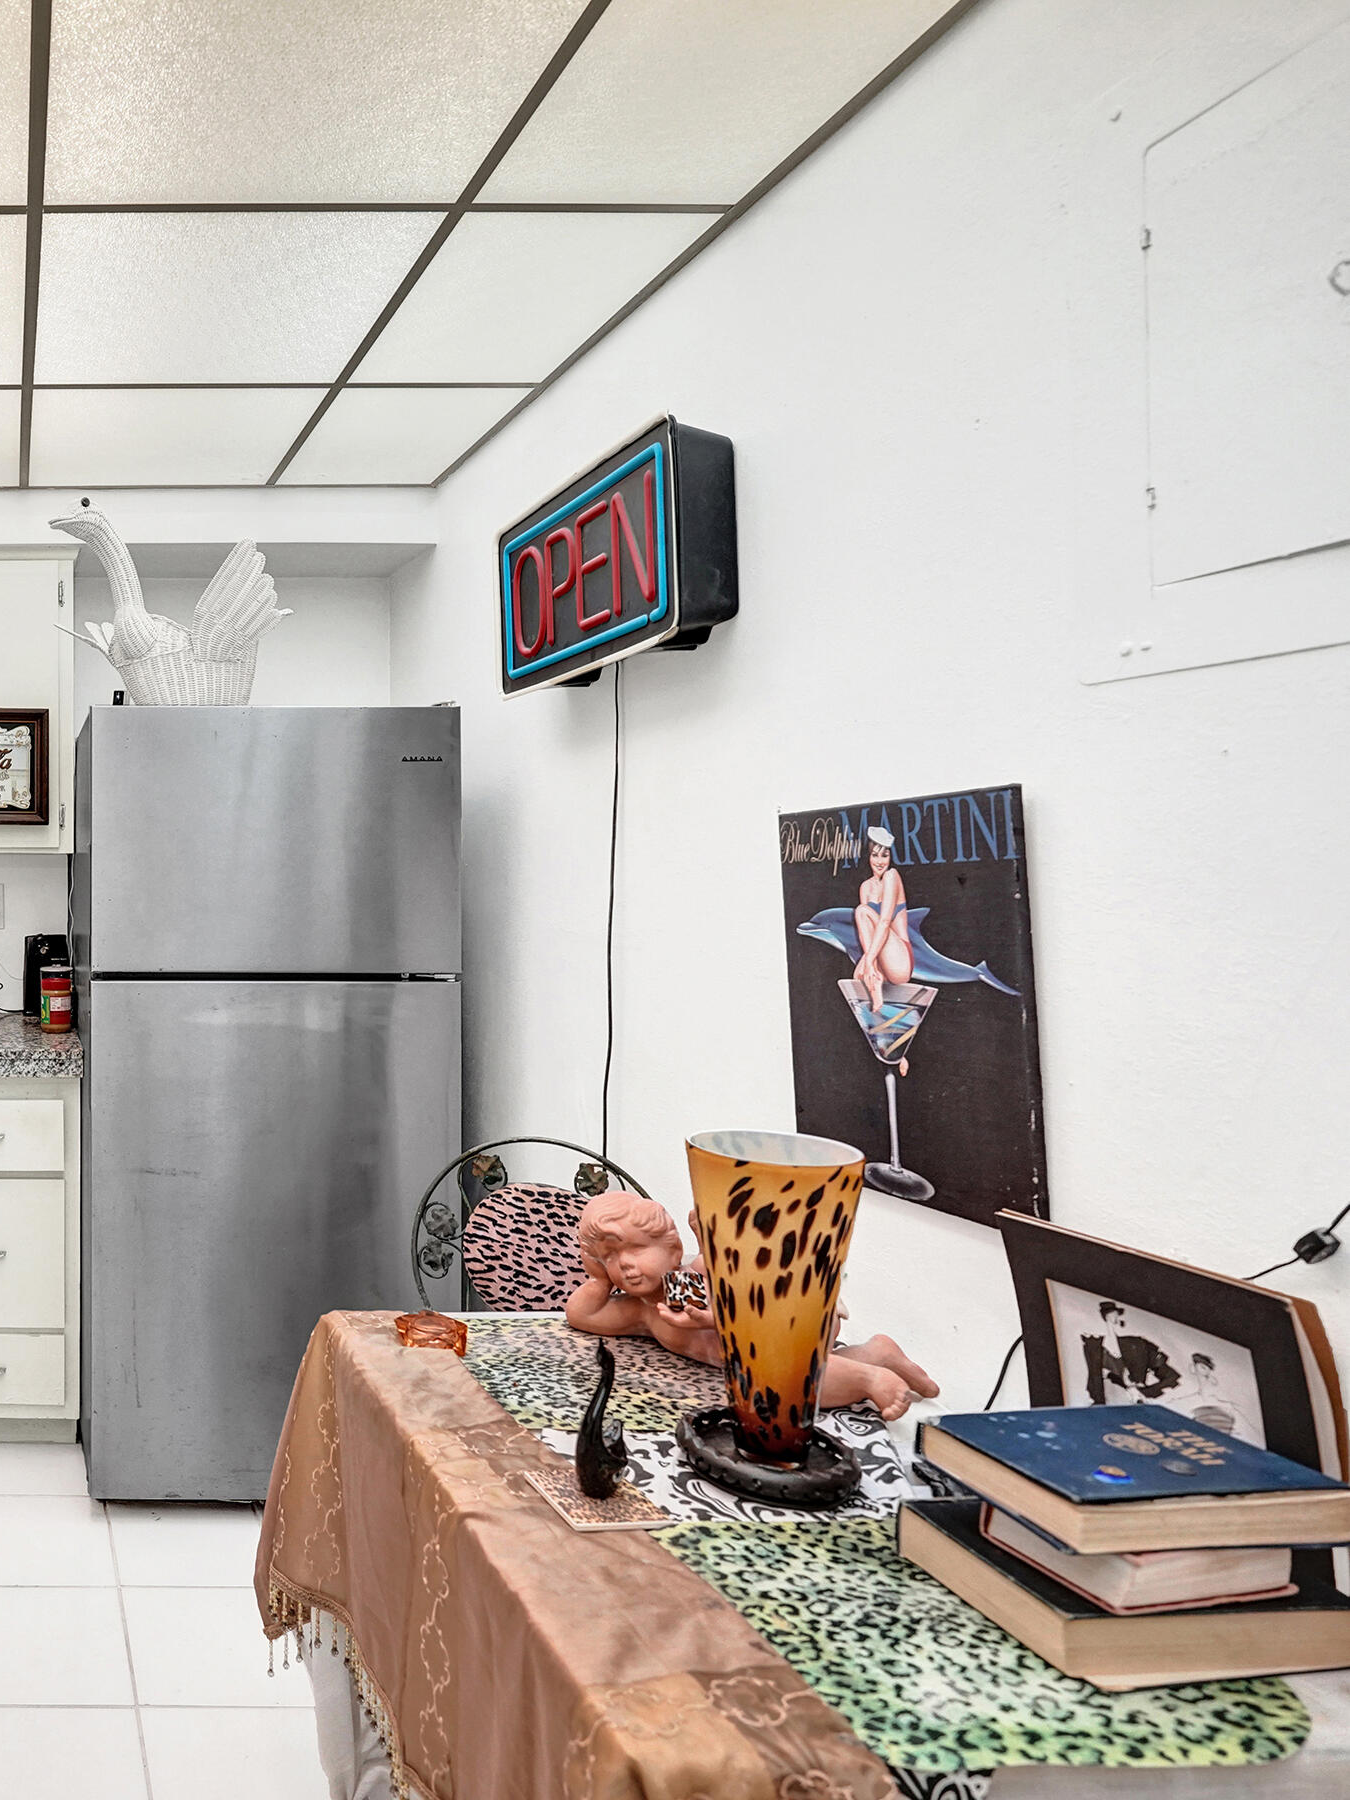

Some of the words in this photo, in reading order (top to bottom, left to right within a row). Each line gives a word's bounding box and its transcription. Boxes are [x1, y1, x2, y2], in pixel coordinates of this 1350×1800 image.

[513, 470, 656, 658] OPEN
[780, 821, 810, 863] Blue
[810, 817, 862, 876] Dolphin
[1120, 1422, 1226, 1466] TORAH
[1165, 1430, 1234, 1454] THE
